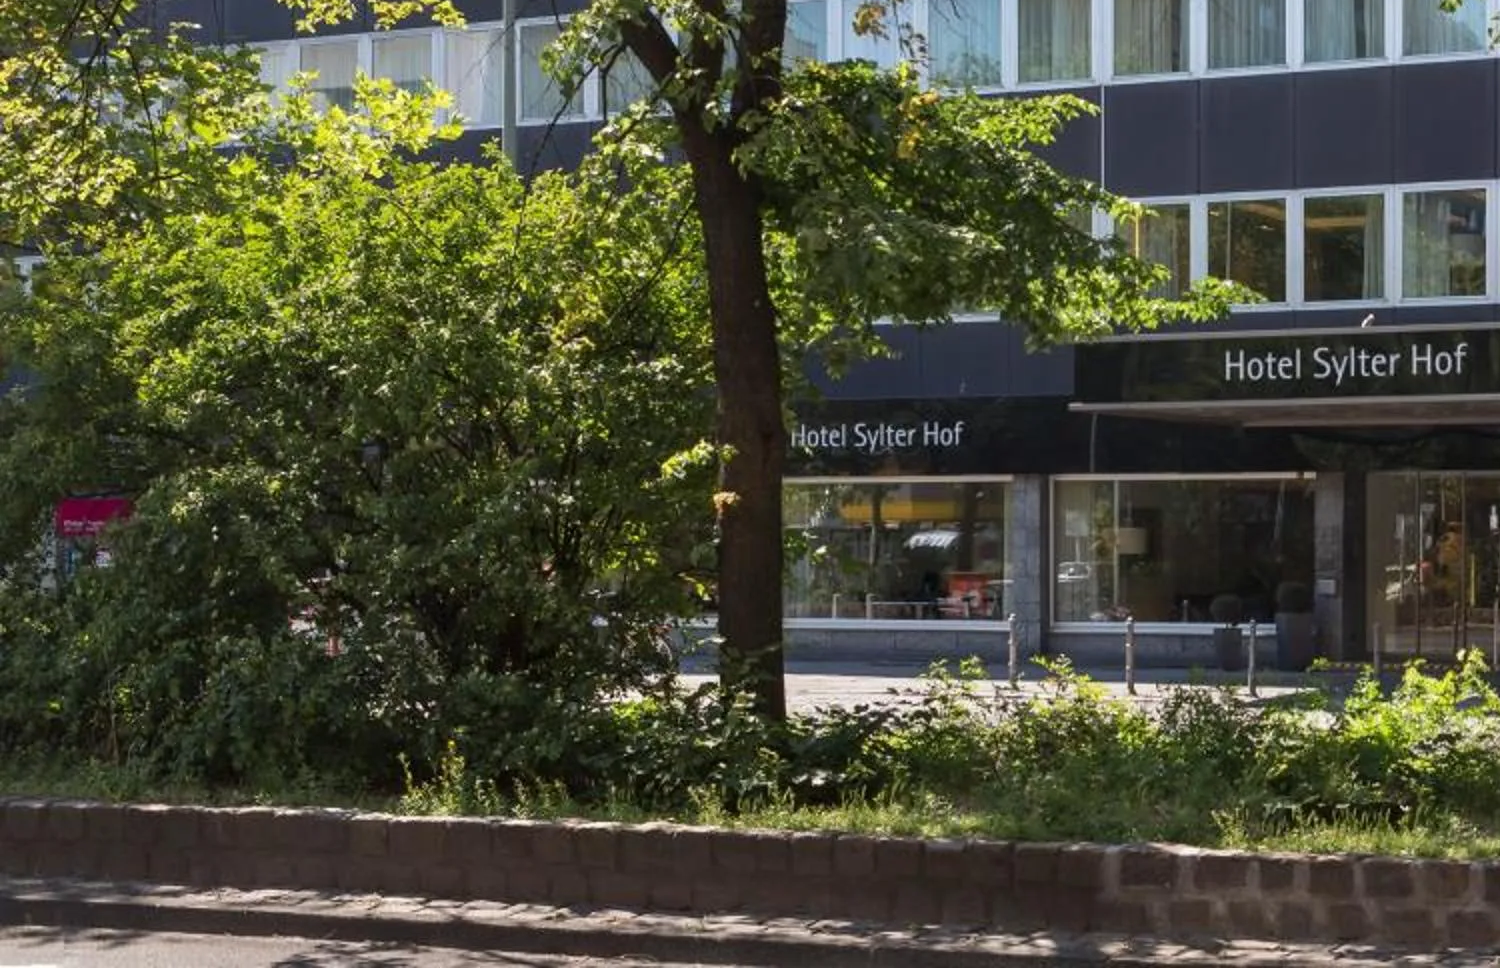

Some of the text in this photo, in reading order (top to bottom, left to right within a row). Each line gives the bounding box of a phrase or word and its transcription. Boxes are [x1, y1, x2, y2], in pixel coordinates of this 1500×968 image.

[1225, 342, 1468, 386] Hotel Sylter Hof
[791, 421, 965, 454] Hotel Sylter Hof
